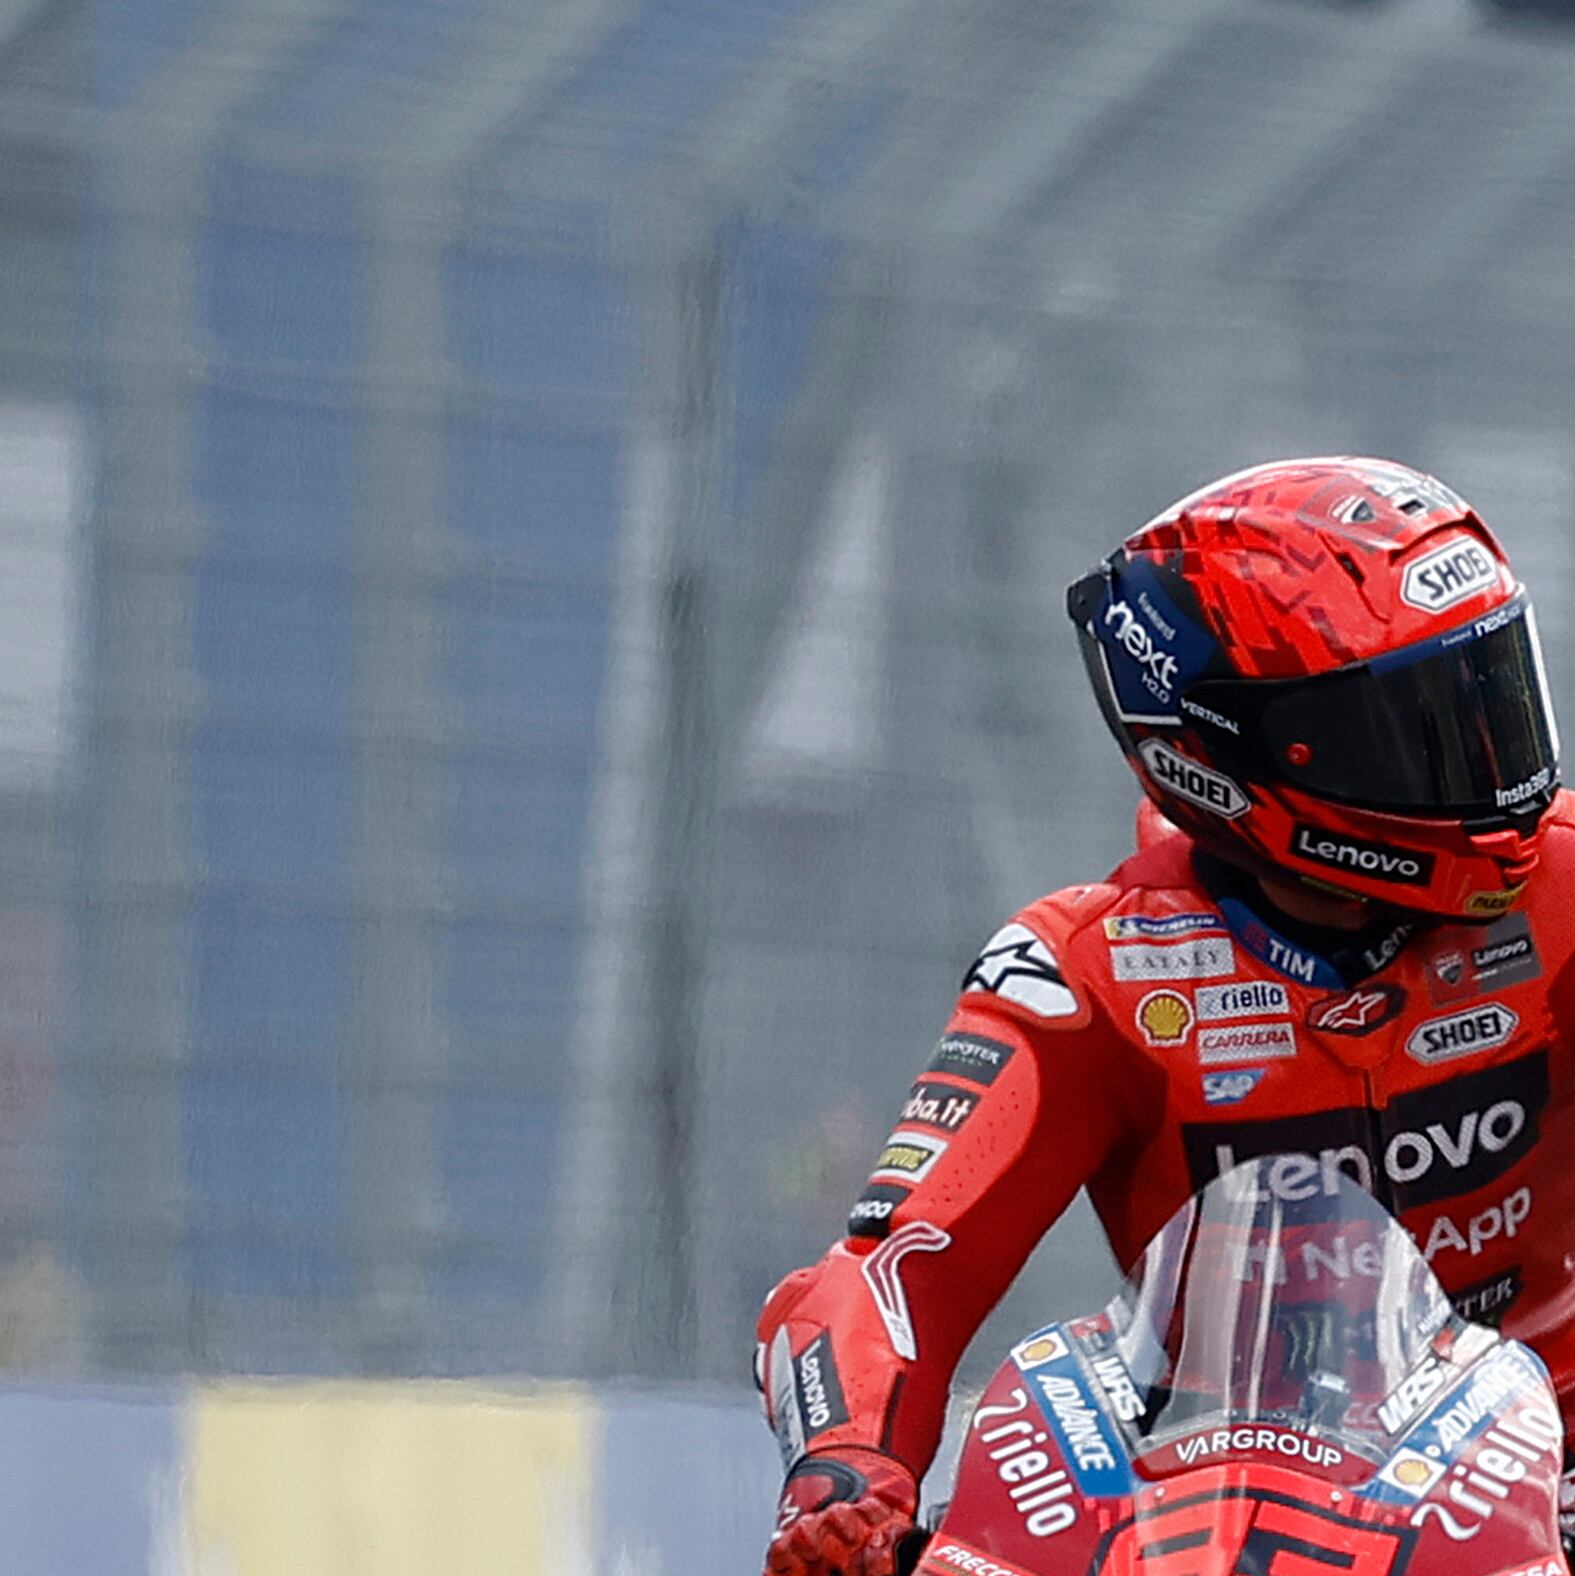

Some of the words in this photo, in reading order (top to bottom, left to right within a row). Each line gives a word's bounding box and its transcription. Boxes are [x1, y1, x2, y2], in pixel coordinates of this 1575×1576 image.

[1105, 600, 1179, 689] next
[1180, 697, 1241, 735] VERTICAL
[1153, 750, 1232, 810] SHOEI
[1299, 829, 1420, 877] Lenovo
[1124, 950, 1220, 970] EATALY
[1269, 939, 1317, 983] TIM
[1221, 984, 1283, 1010] riello
[1202, 1030, 1290, 1049] CARRERA
[1423, 1011, 1501, 1053] SHOEI
[1215, 1100, 1527, 1202] Lenovo
[801, 1339, 831, 1428] Lenovo
[980, 1420, 1077, 1537] riello
